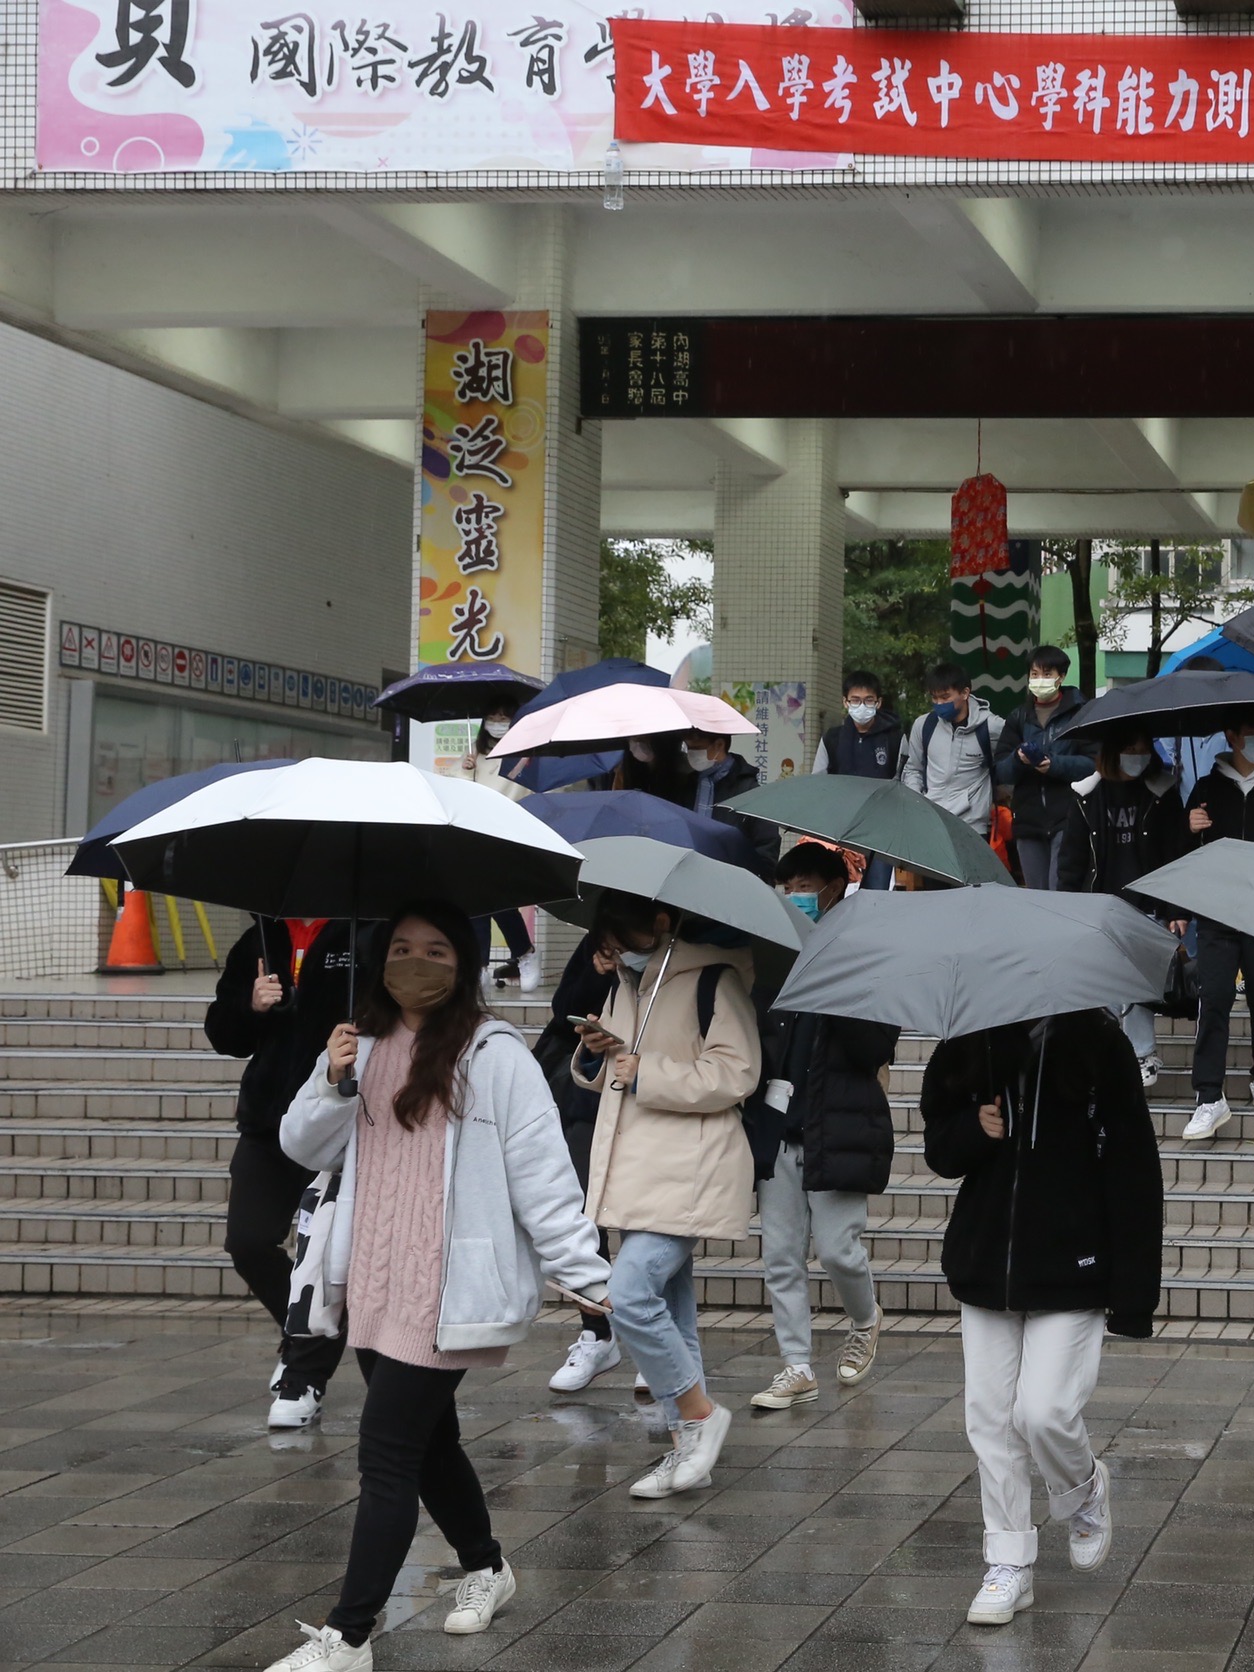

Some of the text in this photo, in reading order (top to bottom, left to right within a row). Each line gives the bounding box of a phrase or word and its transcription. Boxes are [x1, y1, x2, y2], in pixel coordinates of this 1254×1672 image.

[650, 331, 667, 405] 第十八屆
[449, 341, 512, 658] 湖泛靈光
